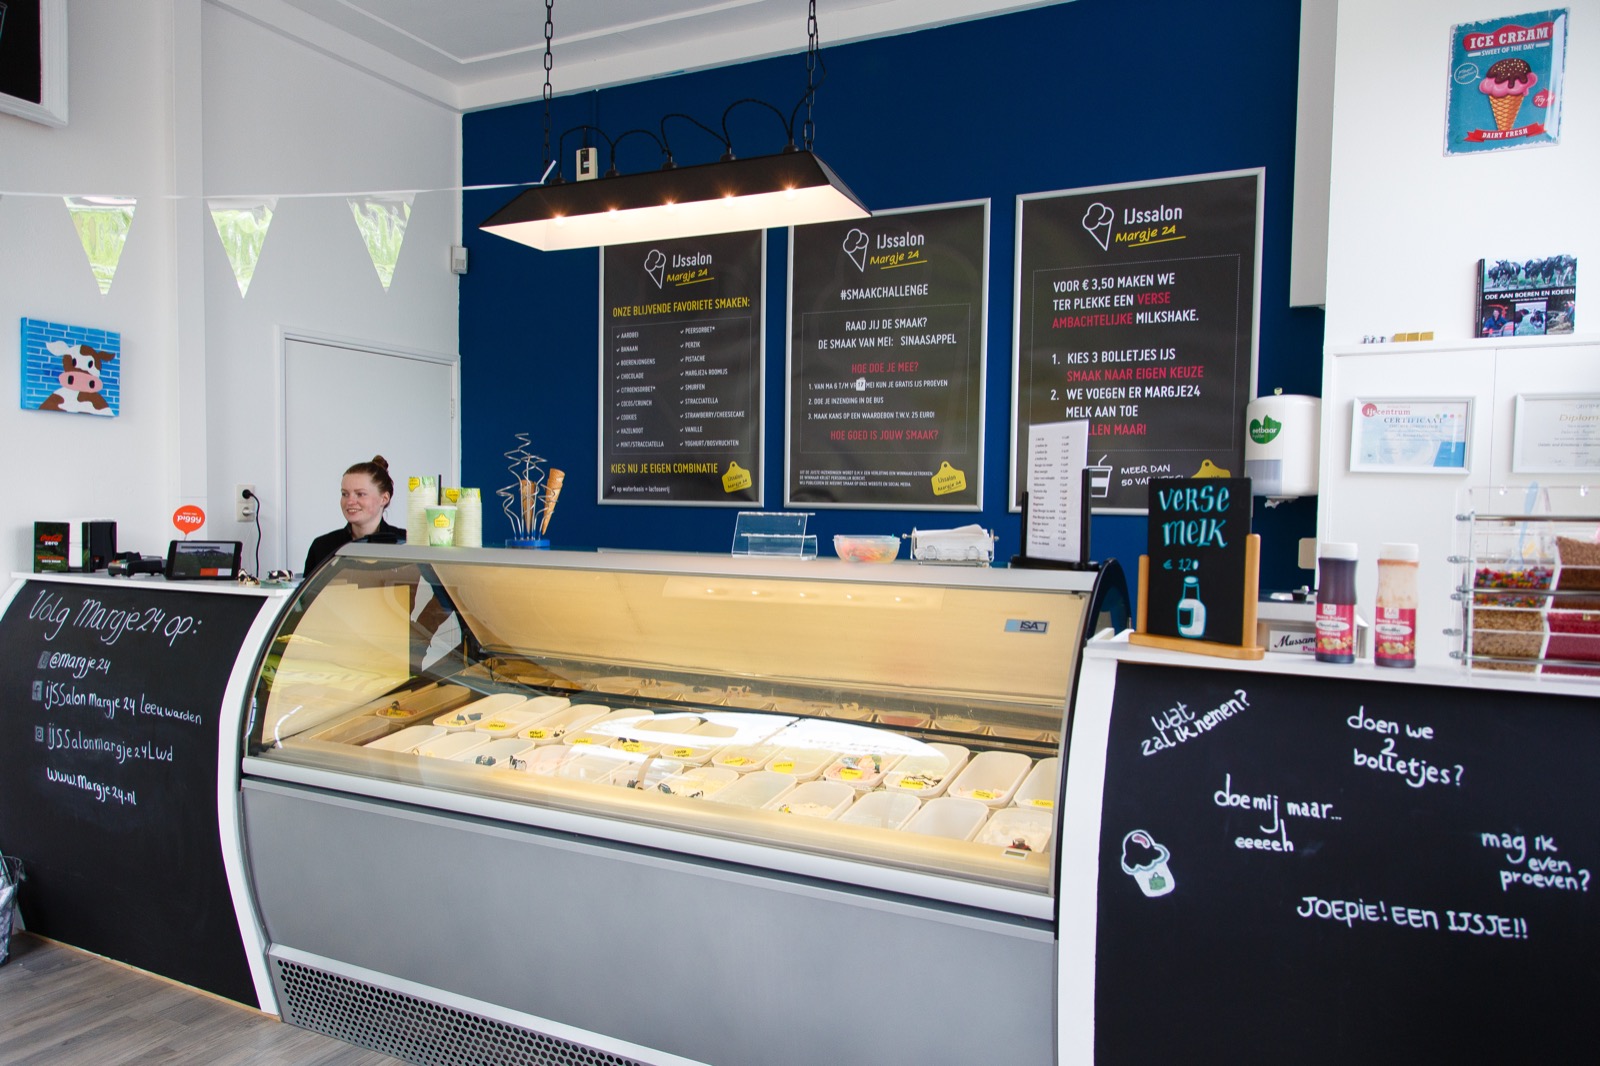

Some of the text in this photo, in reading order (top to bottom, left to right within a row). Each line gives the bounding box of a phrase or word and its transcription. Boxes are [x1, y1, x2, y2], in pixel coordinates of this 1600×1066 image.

[1470, 27, 1548, 49] ICE CREAM
[1481, 48, 1500, 56] SWEET
[1482, 128, 1528, 138] DAIRY FRESH
[1124, 205, 1183, 225] IJssalon
[877, 231, 924, 249] IJssalon
[1115, 225, 1176, 243] Margje 24
[672, 252, 712, 268] IJssalon
[870, 250, 920, 265] Margje 24
[667, 268, 708, 282] Margje 24
[1053, 273, 1175, 293] VOOR € 3,50 MAKEN WE
[840, 284, 928, 300] #SMAAKCHALLENGE
[613, 297, 750, 317] ONZE BLIJVENDE FAVORIETE SMAKEN:
[1053, 292, 1171, 311] TER PLEKKE EEN VERSE
[846, 317, 927, 332] RAAD JIJ DE SMAAK?
[1052, 310, 1199, 328] AMBACHTELIJKE MILKSHAKE.
[818, 334, 956, 349] DE SMAAK VAN MEI: SINAASAPPEL
[621, 358, 655, 366] BOERENJONGENS
[1052, 348, 1176, 365] 1. KIES 3 BOLLETJES IJS
[852, 361, 918, 374] HOE DOE JE MEE?
[1067, 366, 1204, 382] SMAAK NAAR EIGEN KEUZE
[895, 379, 948, 388] GRATIS PROEVEN
[1051, 385, 1201, 400] 2. WE VOEGEN ER MARGJE24
[685, 411, 745, 419] STRAWBERRY/CHEESECAKE
[1066, 405, 1138, 418] MELK AAN TOE
[831, 430, 939, 440] HOE GOED IS JOUW SMAAK?
[1114, 424, 1146, 435] MAAR!
[611, 463, 718, 473] KIES NU JE EIGEN COMBINATIE
[1121, 464, 1170, 474] MEER DAN
[1121, 478, 1133, 486] 50
[177, 515, 201, 524] piggy
[1163, 559, 1172, 569] €
[29, 589, 71, 641] Volg
[164, 615, 202, 647] op:
[1020, 621, 1038, 629] ISA
[123, 697, 135, 716] 24
[140, 693, 202, 725] Leeuwarden
[1141, 689, 1250, 756] zal ik nemen?
[1346, 705, 1433, 739] doen we
[1381, 738, 1398, 757] 2
[1354, 748, 1464, 788] bolletjes?
[1214, 773, 1342, 834] doe mij maar...
[1234, 818, 1294, 852] eeeeh
[1481, 833, 1557, 864] mag ik
[1527, 857, 1571, 873] even
[1500, 869, 1590, 891] proeven?
[1446, 910, 1528, 939] IJSJE!!
